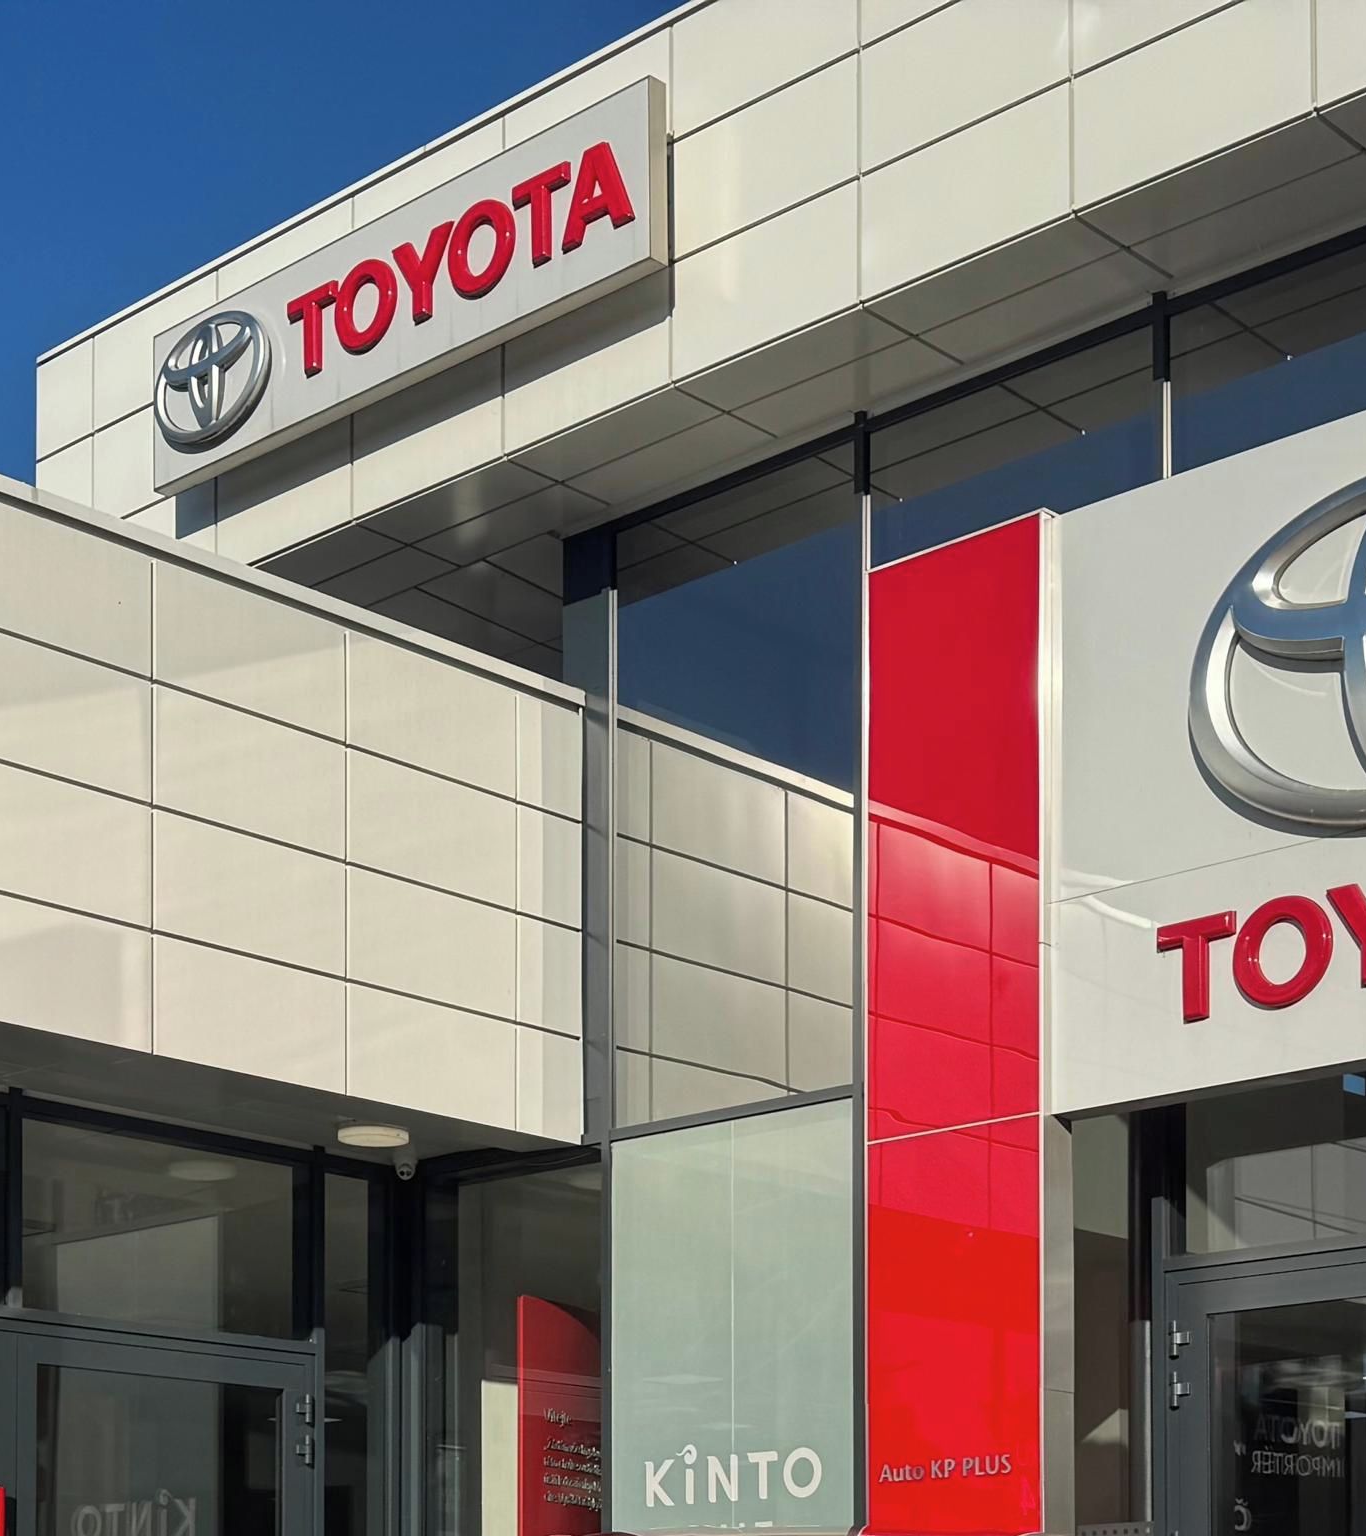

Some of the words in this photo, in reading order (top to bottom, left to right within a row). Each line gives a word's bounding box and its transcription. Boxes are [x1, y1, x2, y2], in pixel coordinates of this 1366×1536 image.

[287, 142, 635, 378] TOYOTA
[879, 1463, 924, 1484] Auto
[930, 1459, 956, 1479] KP
[962, 1454, 1012, 1477] PLUS
